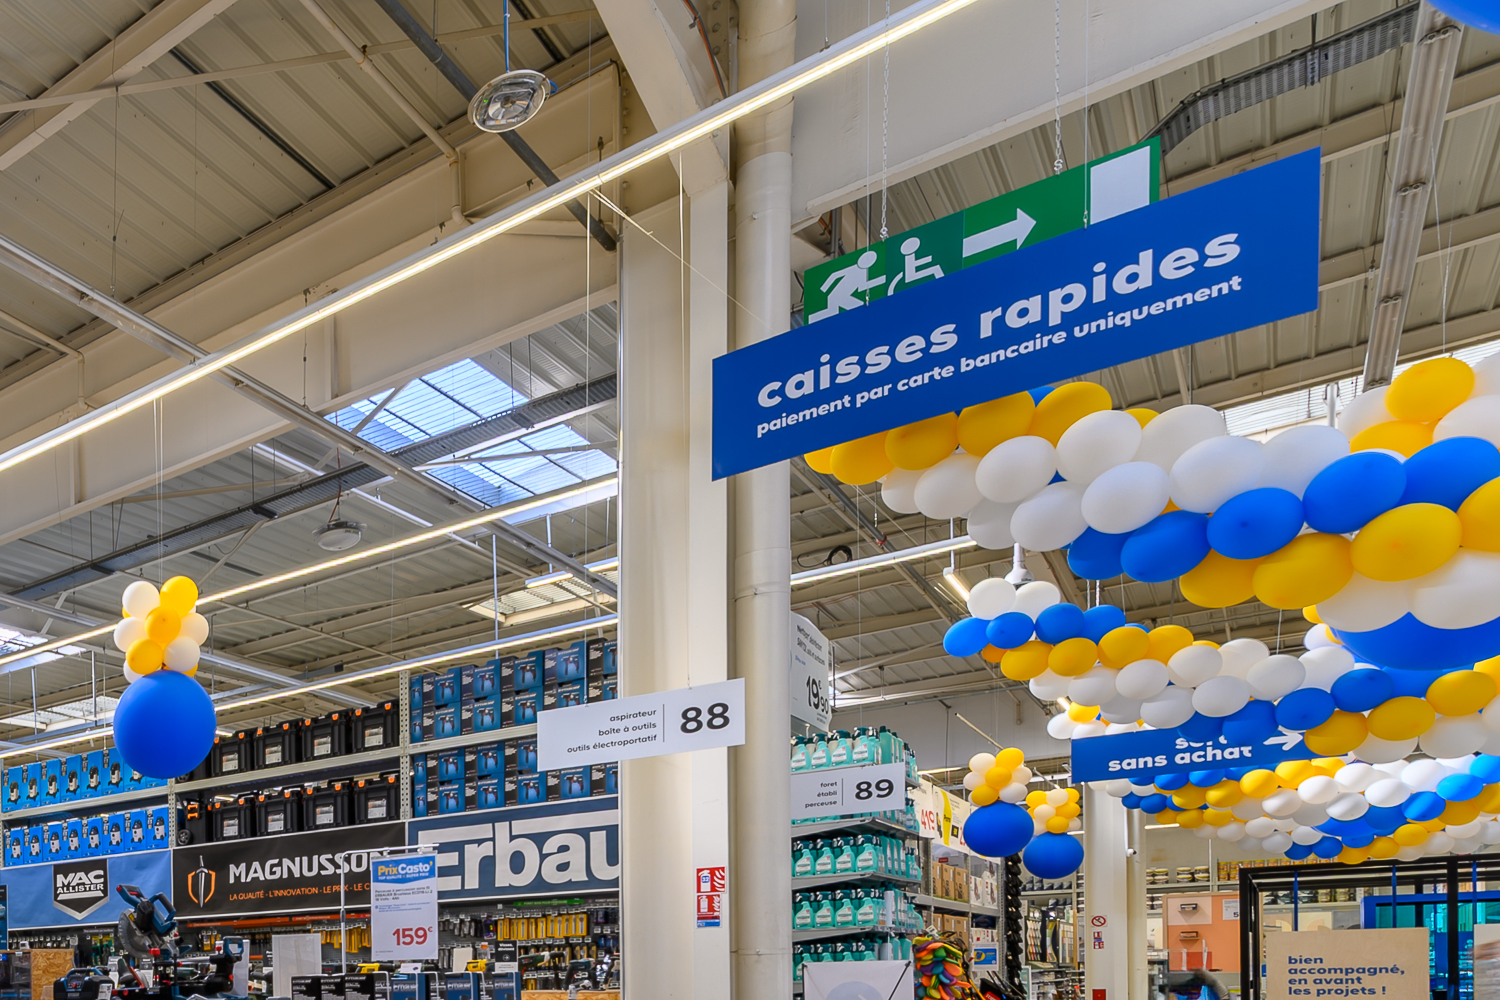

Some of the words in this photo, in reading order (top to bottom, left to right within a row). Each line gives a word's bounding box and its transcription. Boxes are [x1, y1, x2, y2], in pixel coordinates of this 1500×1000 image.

[757, 322, 958, 409] caisses
[978, 231, 1242, 340] rapides
[756, 391, 851, 439] paiement
[855, 384, 893, 411] par
[896, 361, 955, 392] carte
[959, 329, 1067, 373] bancaire
[1073, 274, 1242, 339] uniquement
[609, 709, 657, 722] aspirateur
[680, 702, 730, 734] 88
[598, 726, 621, 736] boîte
[623, 724, 629, 733] à
[632, 722, 657, 732] outils
[567, 744, 590, 754] outils
[592, 734, 657, 750] électroportatif
[1108, 754, 1168, 772] sans
[1174, 746, 1252, 766] achat
[817, 790, 837, 798] établi
[855, 779, 894, 800] 89
[805, 800, 837, 808] perceuse
[56, 870, 104, 888] MAC
[57, 883, 104, 894] ALLISTER
[239, 890, 264, 900] QUALITÉ
[269, 887, 318, 898] L'INNOVATION
[323, 885, 332, 893] LE
[332, 884, 349, 893] PRX
[354, 883, 363, 891] LE
[1288, 955, 1323, 965] bien
[1288, 964, 1405, 976] accompagné,
[1288, 977, 1308, 985] en
[1313, 976, 1363, 985] avant
[1288, 986, 1311, 995] les
[1316, 986, 1376, 997] projets
